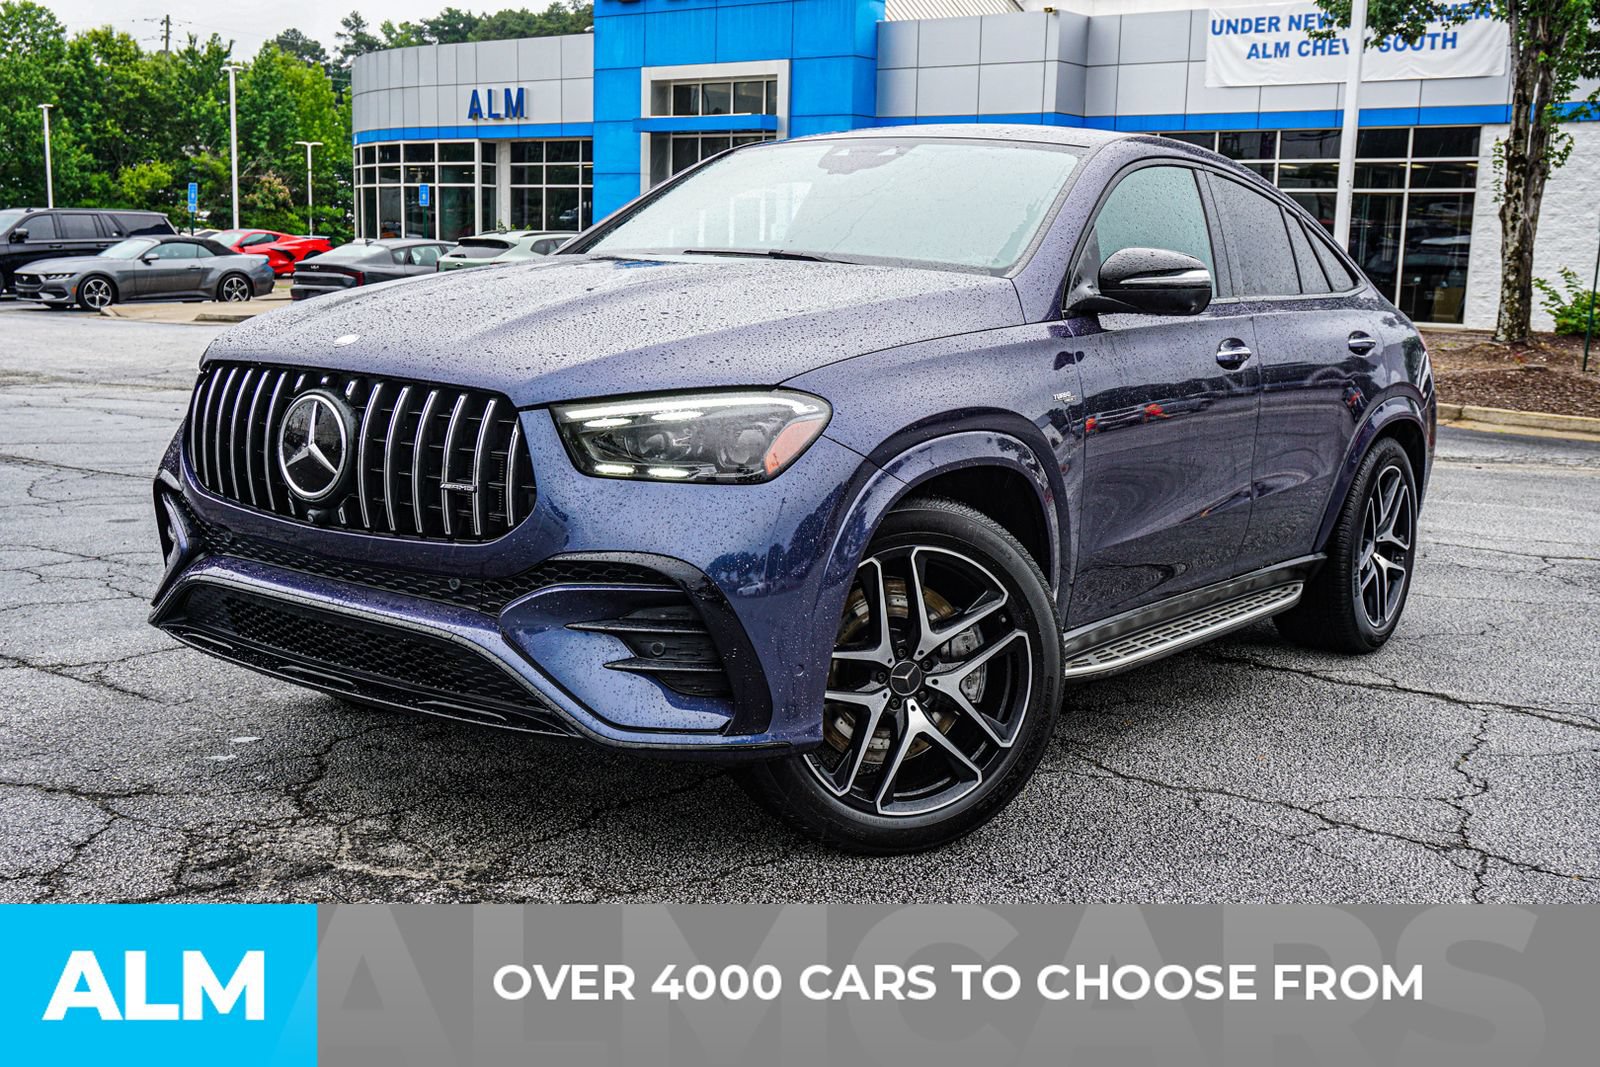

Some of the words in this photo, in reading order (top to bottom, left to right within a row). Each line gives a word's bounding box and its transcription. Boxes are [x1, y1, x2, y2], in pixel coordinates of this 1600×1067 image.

[1211, 16, 1281, 36] UNDER
[1246, 41, 1290, 60] ALM
[467, 87, 526, 120] ALM
